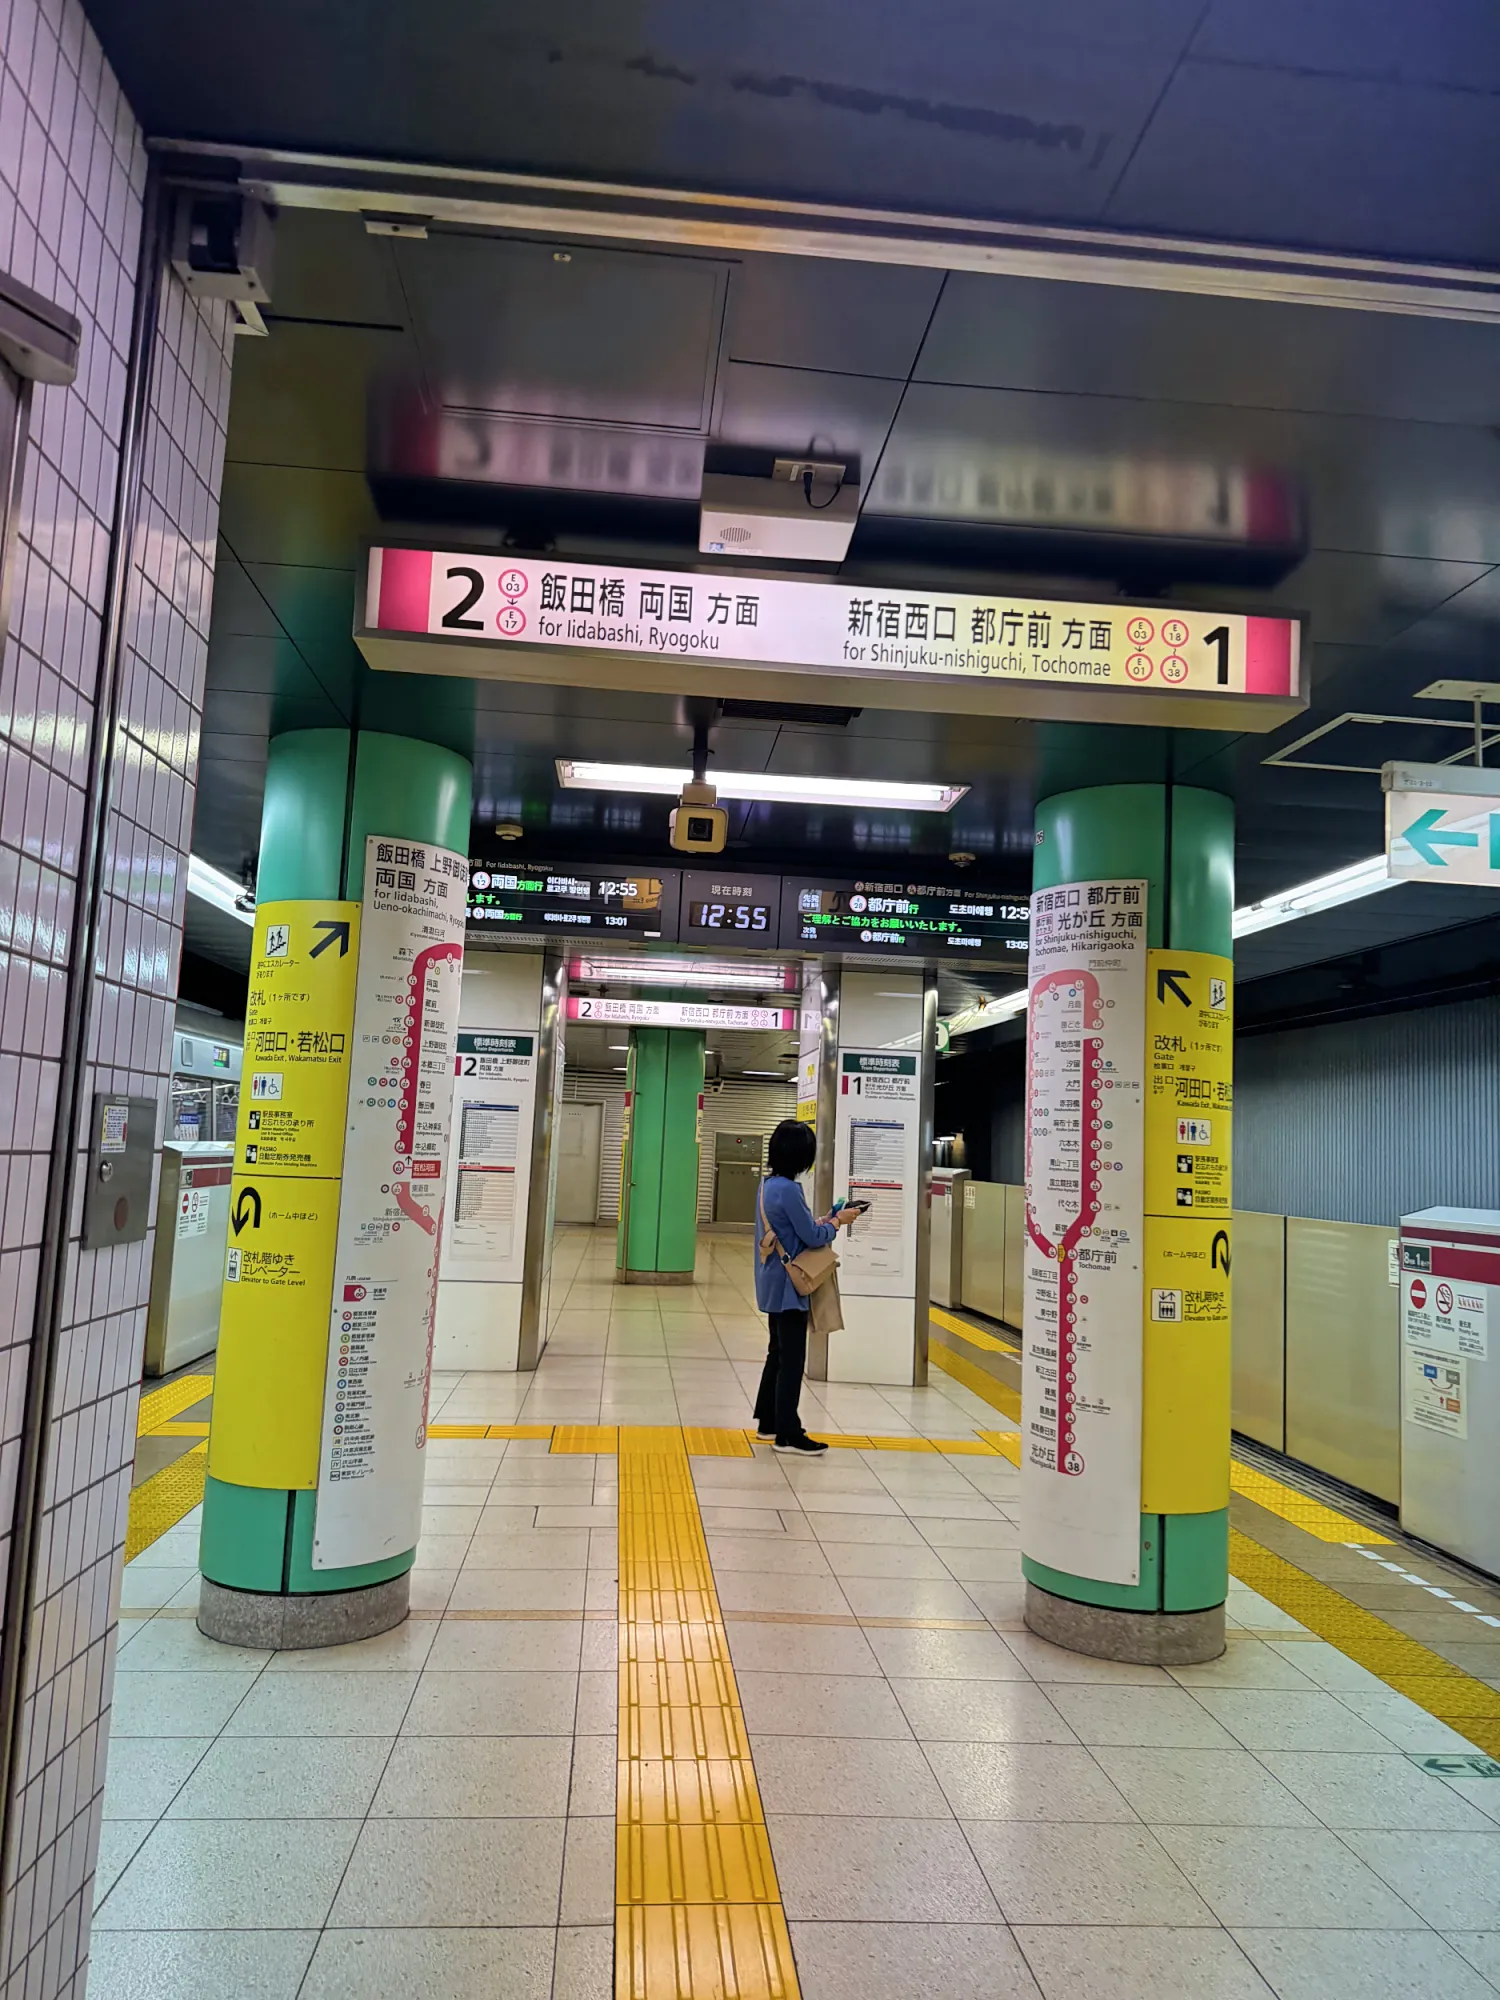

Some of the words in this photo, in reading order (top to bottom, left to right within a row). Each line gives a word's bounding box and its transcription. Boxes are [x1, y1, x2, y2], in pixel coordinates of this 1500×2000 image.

[505, 582, 520, 593] 03
[440, 566, 485, 631] 2
[540, 573, 625, 618] 飯田橋
[640, 582, 693, 622] 両国
[707, 592, 759, 627] 方面
[504, 620, 517, 630] 17
[847, 597, 957, 643] 新宿西口
[971, 606, 1050, 650] 都庁前
[1061, 617, 1112, 652] 方面
[538, 618, 562, 639] for
[566, 620, 644, 646] Iidabashi,
[648, 626, 719, 652] Ryogoku
[1133, 629, 1148, 639] 03
[1169, 631, 1181, 641] 18
[843, 640, 865, 662] for
[870, 642, 1026, 675] Shinjuku-nishiguchi,
[1031, 653, 1111, 677] Tochomae
[1203, 626, 1229, 685] 1
[1132, 666, 1146, 676] 01
[1167, 667, 1181, 678] 38
[376, 843, 426, 869] 飯田橋
[375, 867, 416, 891] 両国
[423, 878, 448, 898] 方面
[491, 874, 544, 892] 両国方面行
[598, 881, 638, 897] 12:55
[710, 884, 753, 897] 現在時刻
[864, 882, 904, 893] 新宿西口
[374, 889, 391, 899] for
[394, 890, 439, 909] Iidabashi,
[802, 894, 820, 903] 先発
[917, 885, 962, 898] 都庁前方面
[868, 897, 920, 915] 都庁前行
[1036, 889, 1080, 914] 新宿西口
[1087, 886, 1140, 906] 都庁前
[373, 900, 448, 923] Ueno-okachimachi,
[701, 904, 766, 930] 12:55
[604, 916, 628, 926] 13:01
[802, 913, 963, 933] ご理解とご協力をお願いいたします。
[1057, 909, 1106, 931] 光が丘
[1111, 911, 1144, 928] 方面
[1005, 940, 1028, 950] 13:05
[1043, 929, 1137, 945] Shinjuku-nishiguchi,
[1071, 941, 1134, 952] Hikarigaoka
[250, 989, 267, 1006] 改札
[581, 1001, 592, 1018] 2
[771, 1011, 780, 1027] 1
[254, 1031, 345, 1054] 河田口・若松口
[1153, 1035, 1187, 1053] 改札
[289, 1055, 327, 1063] Wakamatsu
[1153, 1052, 1175, 1060] Gate
[463, 1057, 477, 1076] 2
[852, 1076, 862, 1095] 1
[1153, 1075, 1174, 1085] 出口
[243, 1250, 295, 1266] 改札階ゆき
[1078, 1248, 1117, 1264] 都庁前
[242, 1263, 300, 1277] エレベーター
[1078, 1261, 1111, 1271] Tochomae
[271, 1278, 286, 1286] Gate
[288, 1278, 306, 1286] Level
[1185, 1290, 1225, 1303] 改札階ゆき
[1185, 1303, 1227, 1315] エレベーター
[1031, 1444, 1056, 1463] 光が丘
[1067, 1462, 1080, 1472] 38
